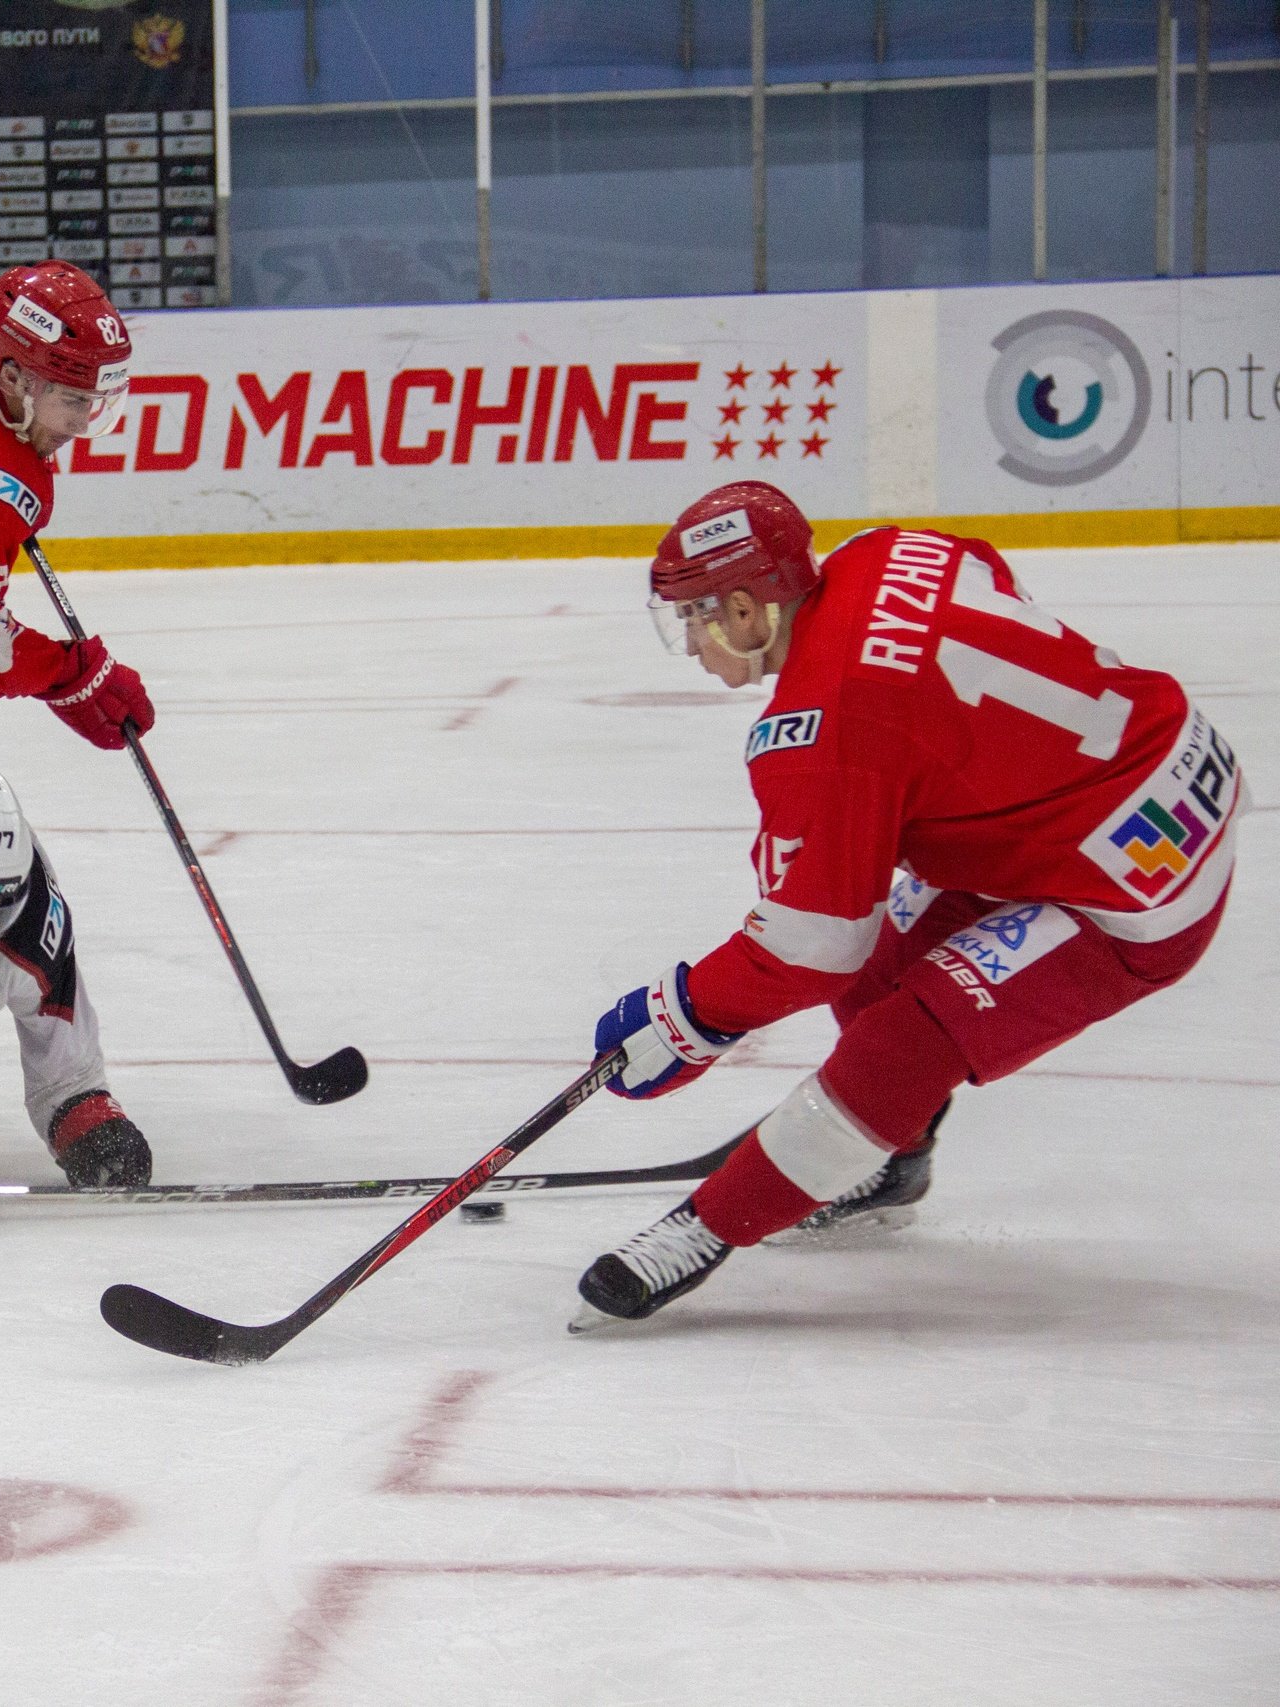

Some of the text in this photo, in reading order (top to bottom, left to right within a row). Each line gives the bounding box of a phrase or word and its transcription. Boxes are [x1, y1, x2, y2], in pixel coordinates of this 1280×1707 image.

[51, 27, 100, 46] ПУТИ
[18, 303, 54, 333] ISKRA
[96, 315, 126, 346] 82
[1166, 351, 1280, 423] int
[223, 361, 700, 470] MACHINE
[689, 520, 738, 543] ISKRA
[32, 548, 74, 617] SHERWOOD
[860, 531, 955, 674] RYZHOV
[746, 713, 817, 753] ARI
[383, 1177, 547, 1198] BAER
